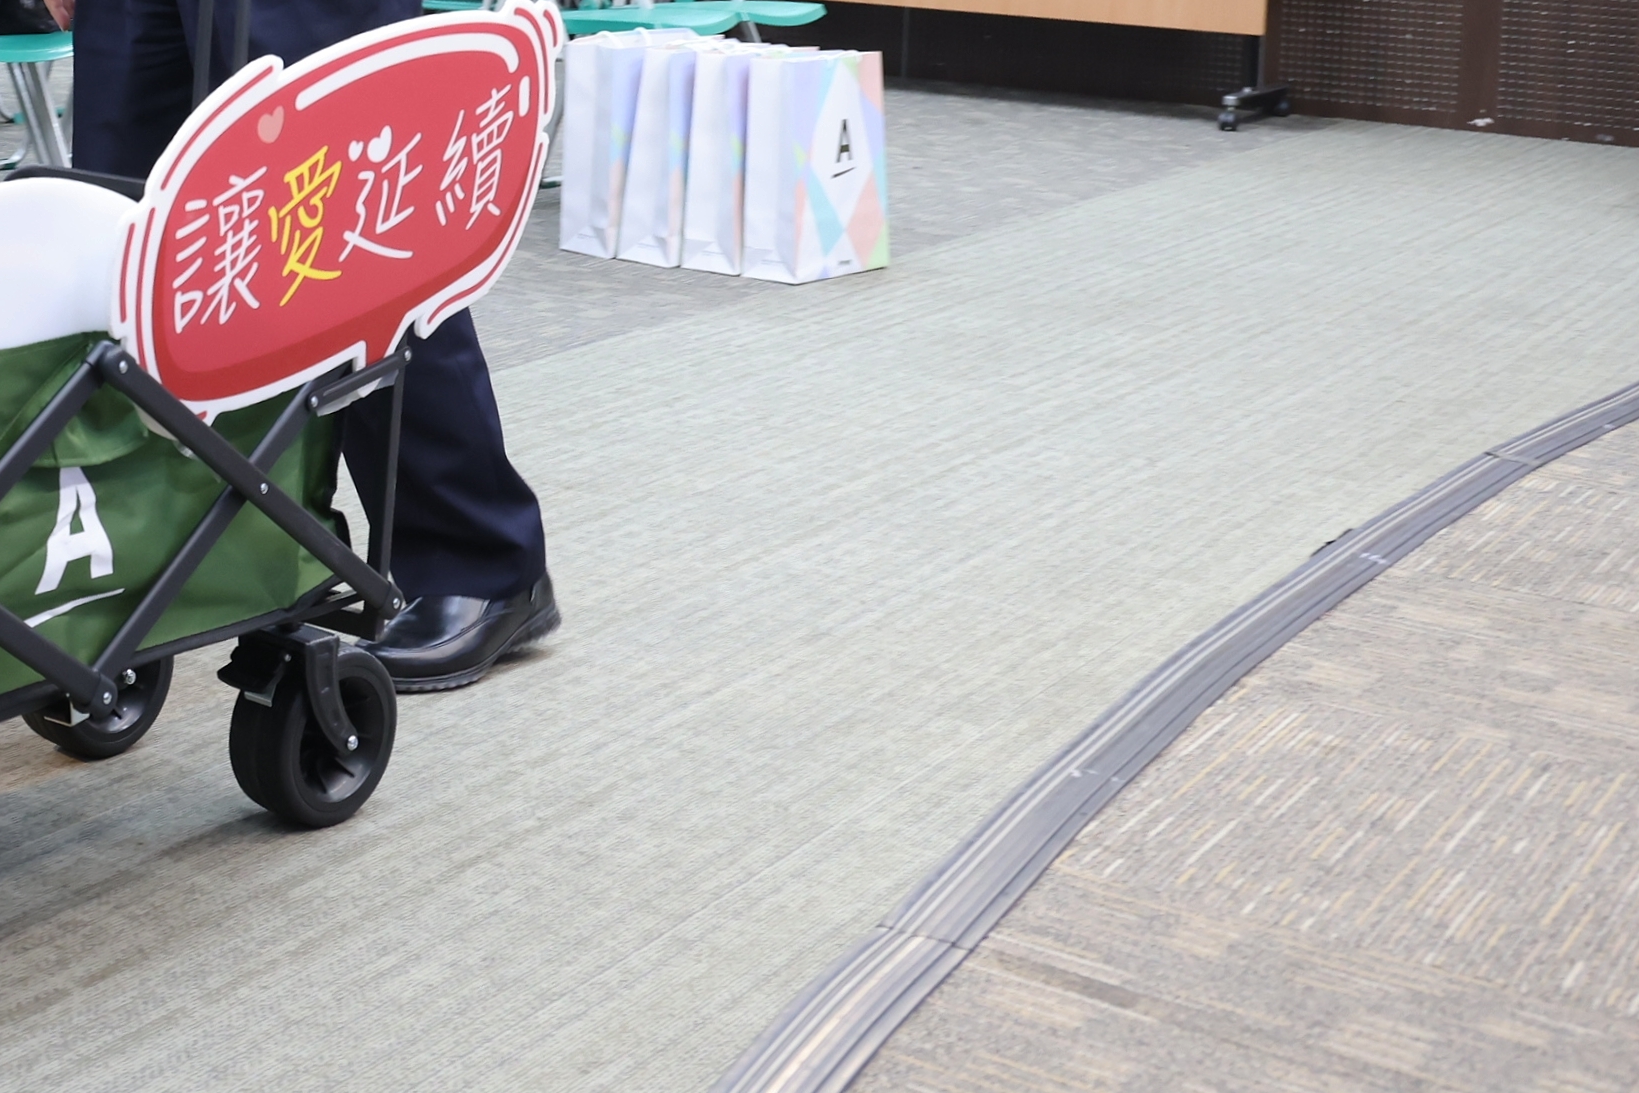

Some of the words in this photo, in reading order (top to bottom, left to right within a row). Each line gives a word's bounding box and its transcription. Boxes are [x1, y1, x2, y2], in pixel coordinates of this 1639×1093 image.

[835, 119, 853, 163] A
[173, 84, 512, 334] 讓愛延續
[35, 467, 114, 595] A
